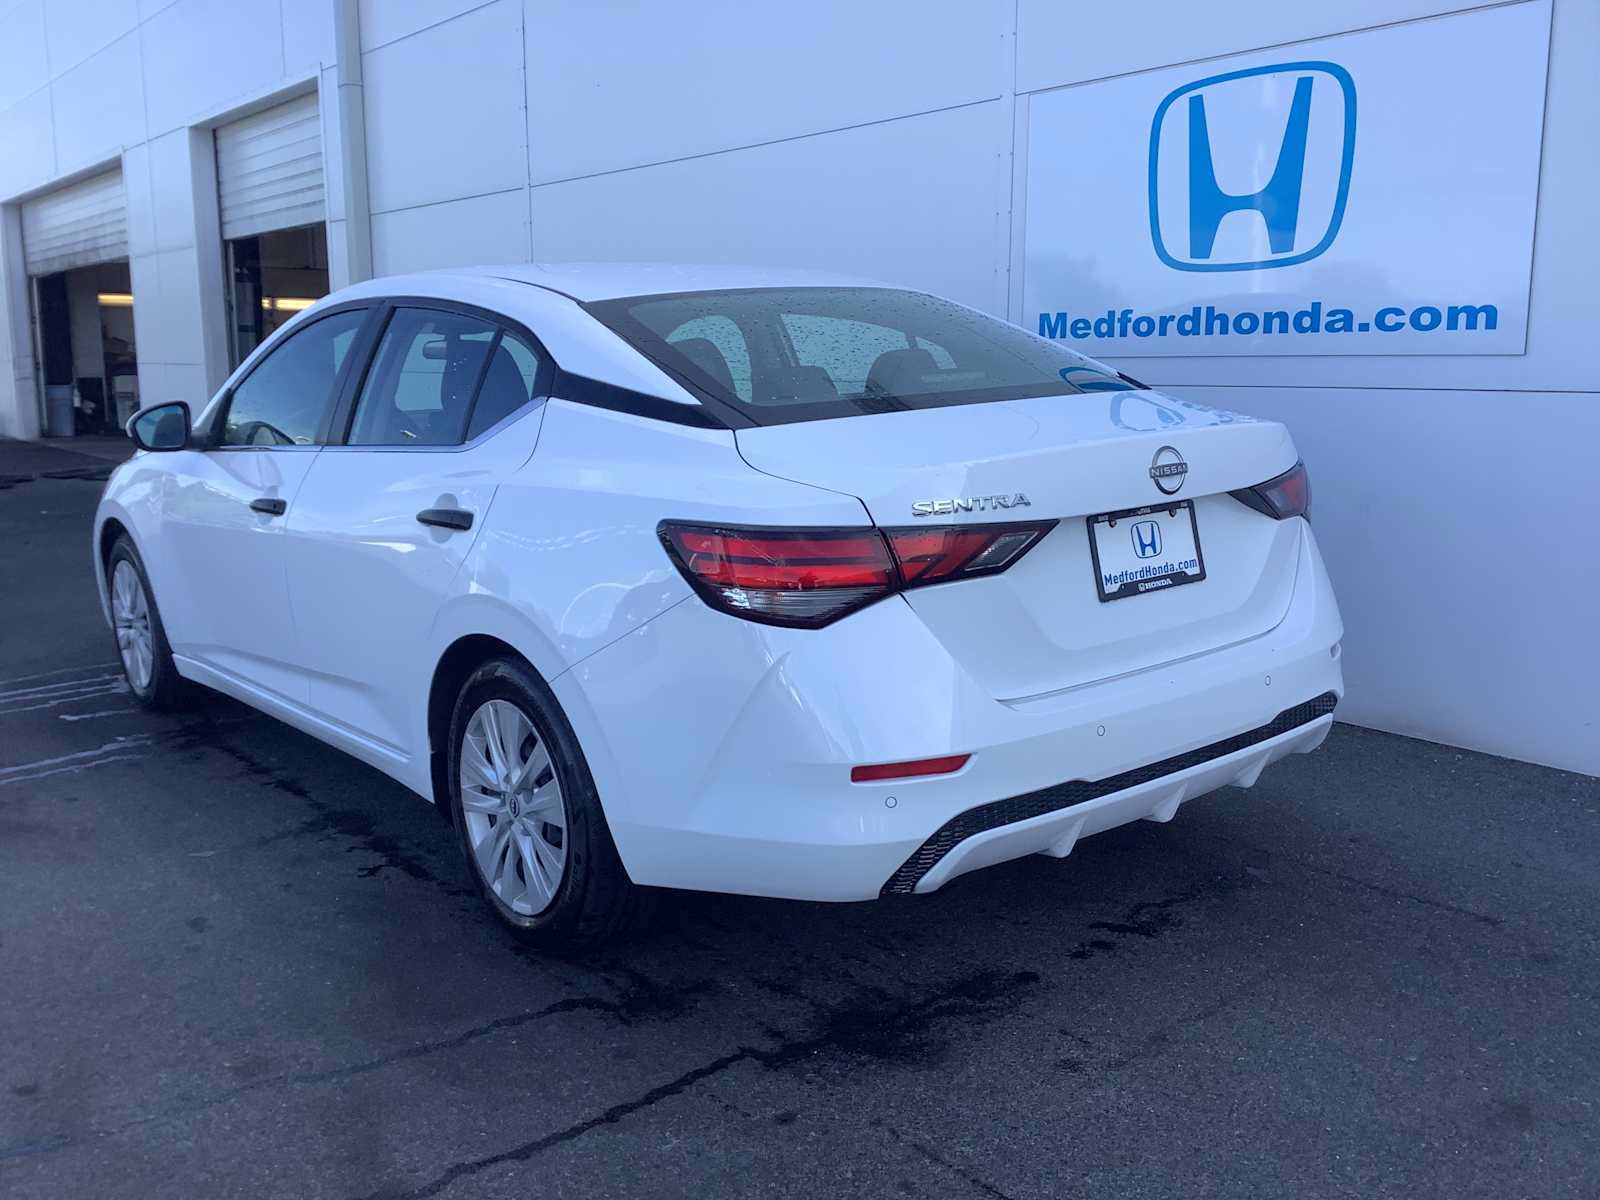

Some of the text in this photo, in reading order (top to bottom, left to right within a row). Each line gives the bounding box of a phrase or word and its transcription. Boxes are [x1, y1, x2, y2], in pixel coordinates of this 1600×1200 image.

[1038, 302, 1498, 339] Medfordhonda.com
[912, 493, 1031, 517] SENTRA
[1104, 559, 1198, 586] MedfordHonda.com
[1145, 578, 1173, 590] HONDA
